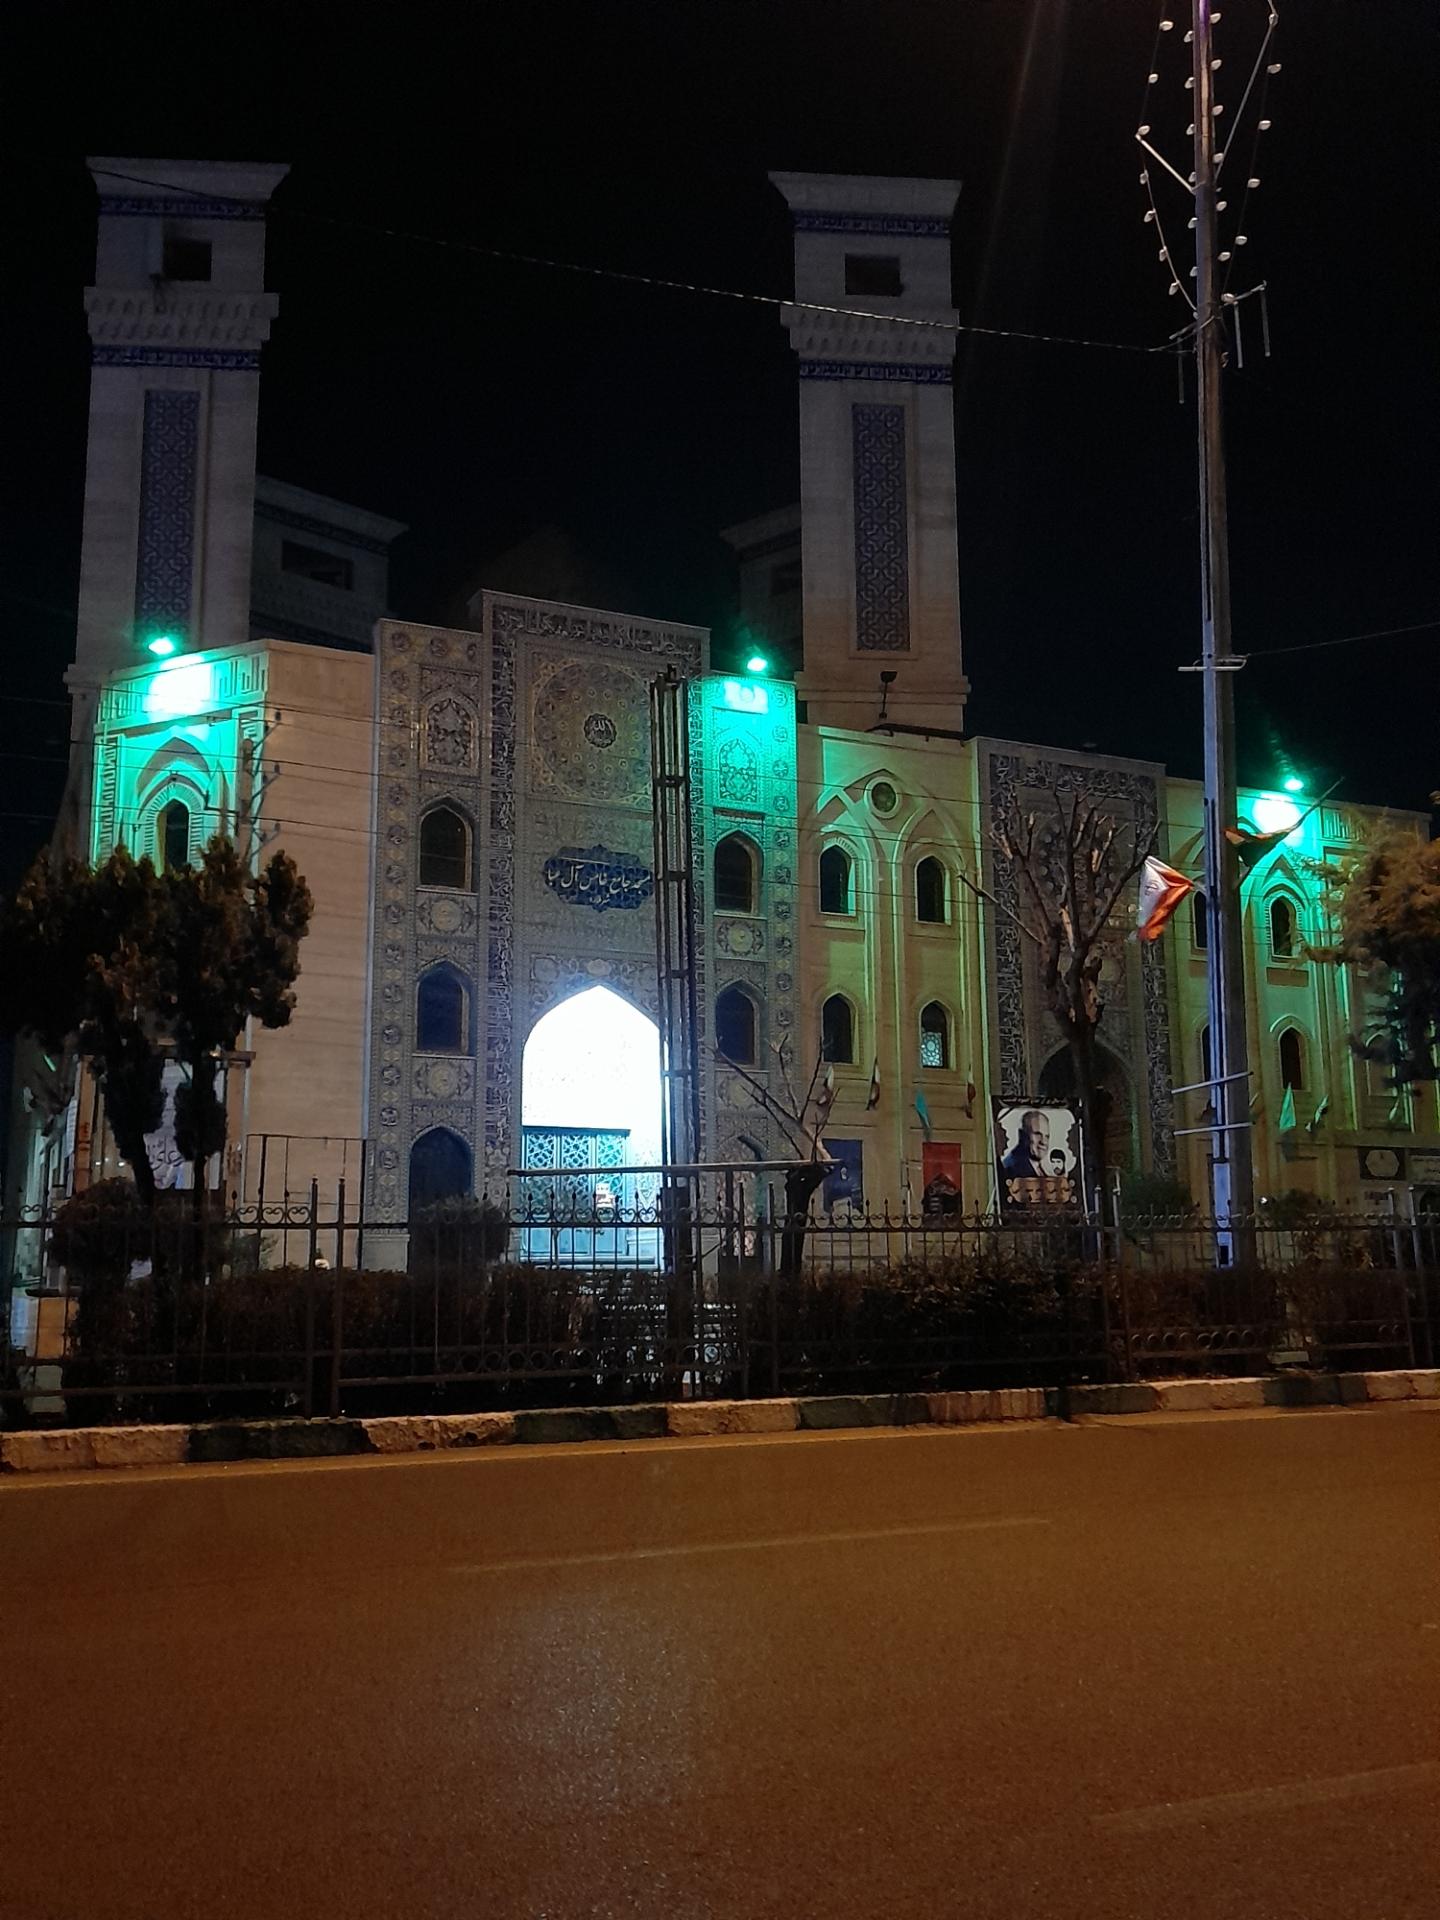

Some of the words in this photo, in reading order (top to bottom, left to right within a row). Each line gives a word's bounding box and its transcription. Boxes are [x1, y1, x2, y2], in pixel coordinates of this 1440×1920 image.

[561, 865, 584, 887] آل
[609, 874, 631, 893] جامع
[630, 873, 651, 893] مسجد
